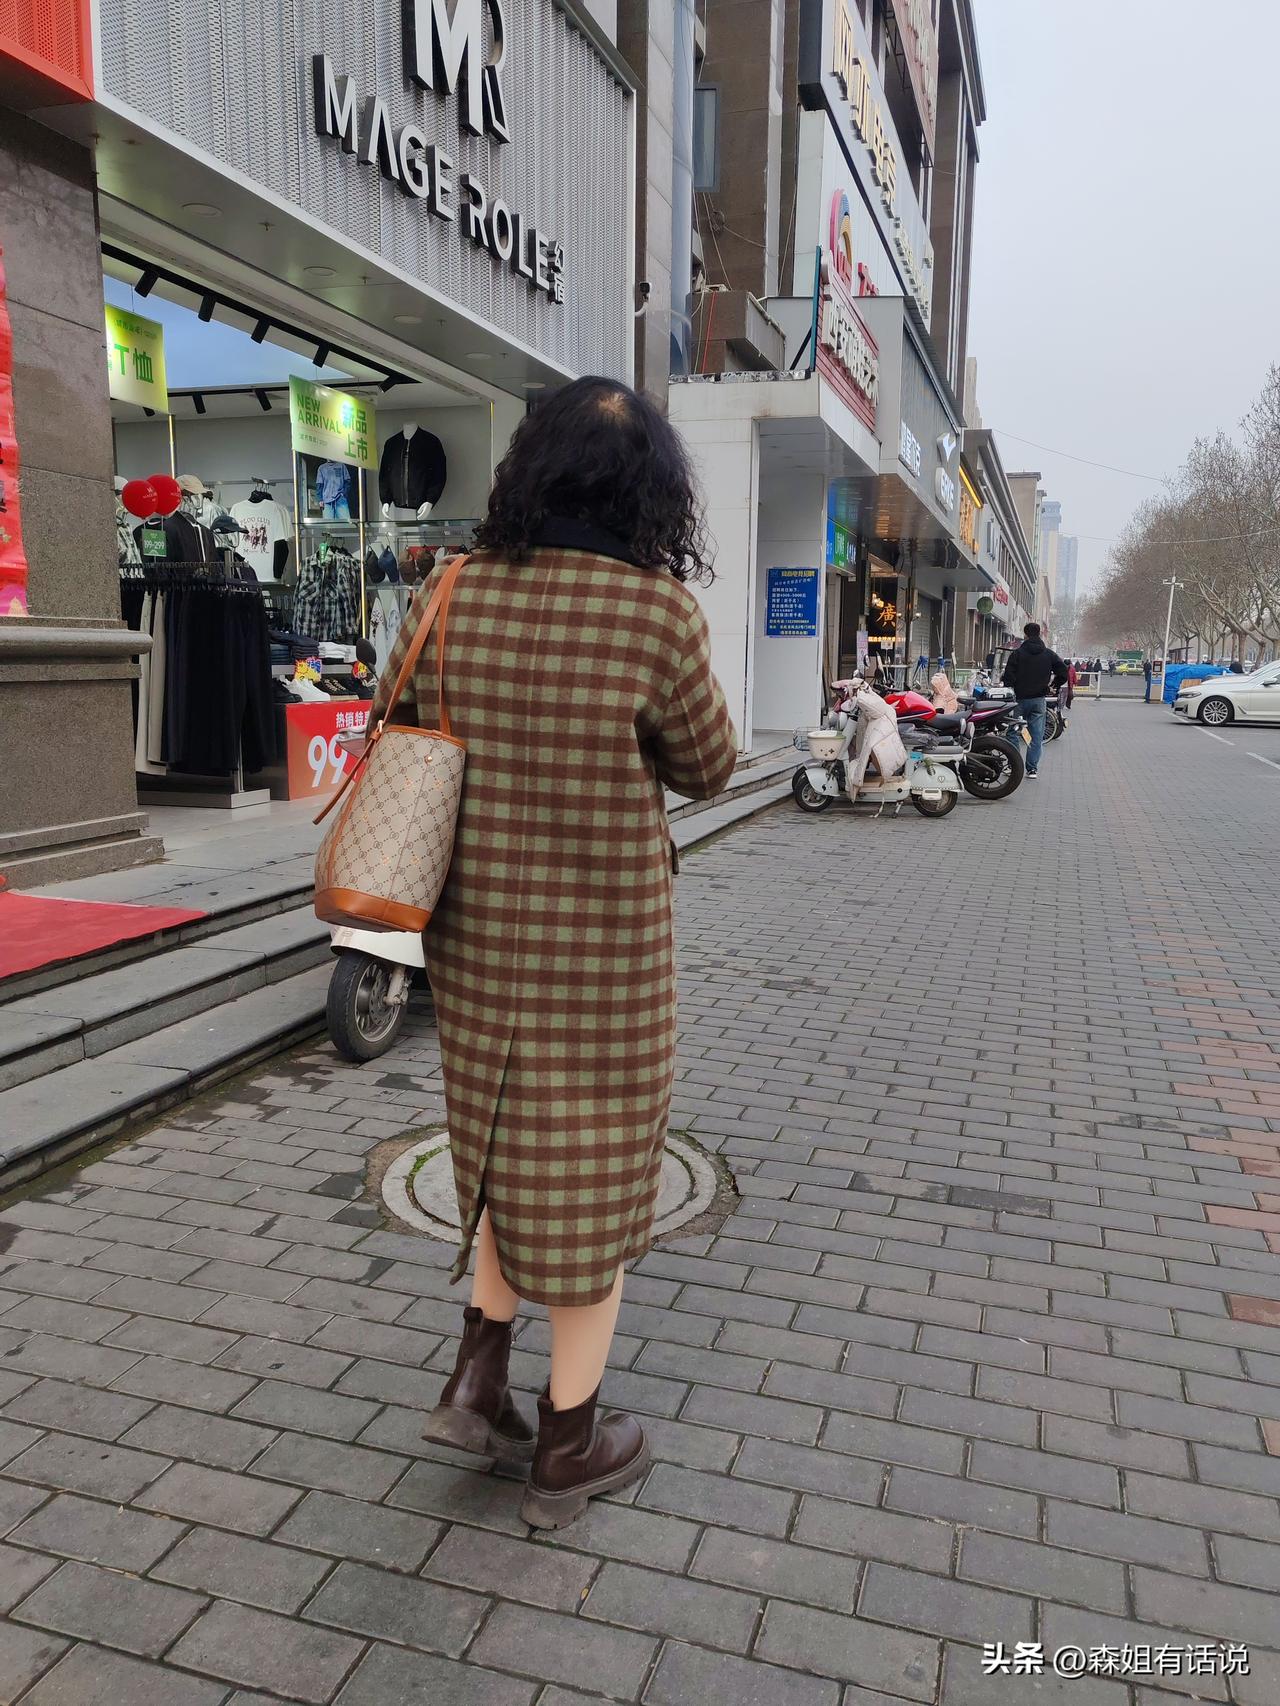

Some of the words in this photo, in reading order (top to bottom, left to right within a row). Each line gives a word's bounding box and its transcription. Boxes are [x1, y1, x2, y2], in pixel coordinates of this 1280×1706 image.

[312, 54, 454, 222] MAGE
[460, 173, 550, 293] ROLE
[297, 392, 320, 413] NEW
[298, 409, 342, 434] ARRIVAL
[342, 402, 367, 435] 新品
[344, 433, 368, 462] 上市
[308, 733, 348, 788] 99
